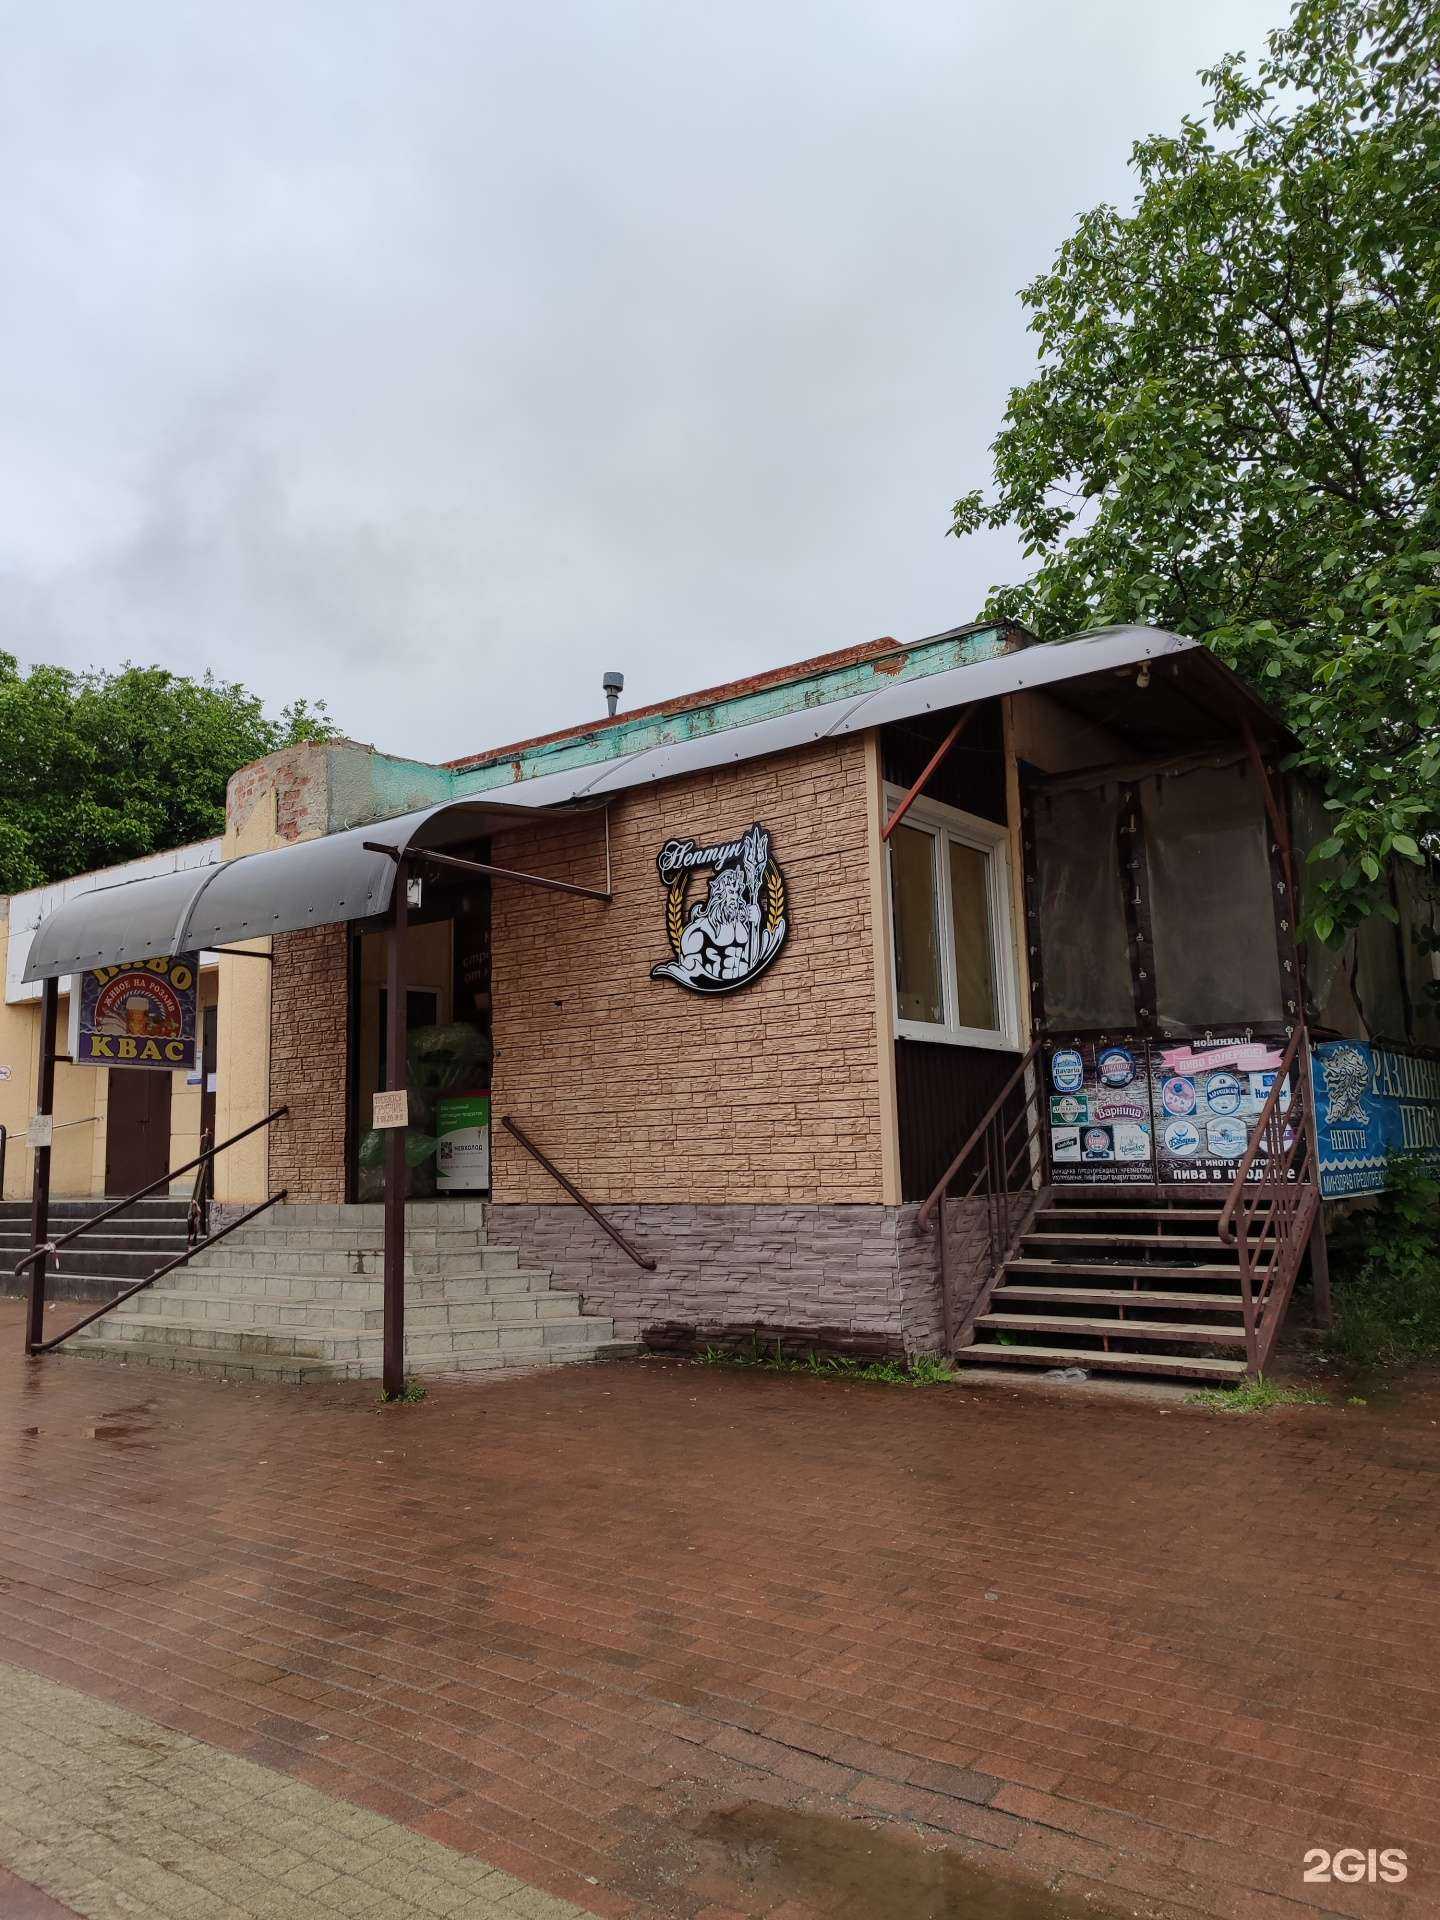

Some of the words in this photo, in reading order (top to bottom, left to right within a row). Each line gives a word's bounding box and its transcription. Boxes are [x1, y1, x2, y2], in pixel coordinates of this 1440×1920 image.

[104, 980, 131, 1007] ЖИВОЕ
[134, 979, 146, 987] НА
[149, 983, 175, 1013] РОЗЛИВ
[90, 1036, 184, 1061] КВАС
[1098, 1106, 1142, 1120] Варница
[1330, 1129, 1367, 1150] НЕПТУН
[1205, 1159, 1234, 1167] много
[1173, 1169, 1207, 1180] пива
[1213, 1169, 1222, 1180] в
